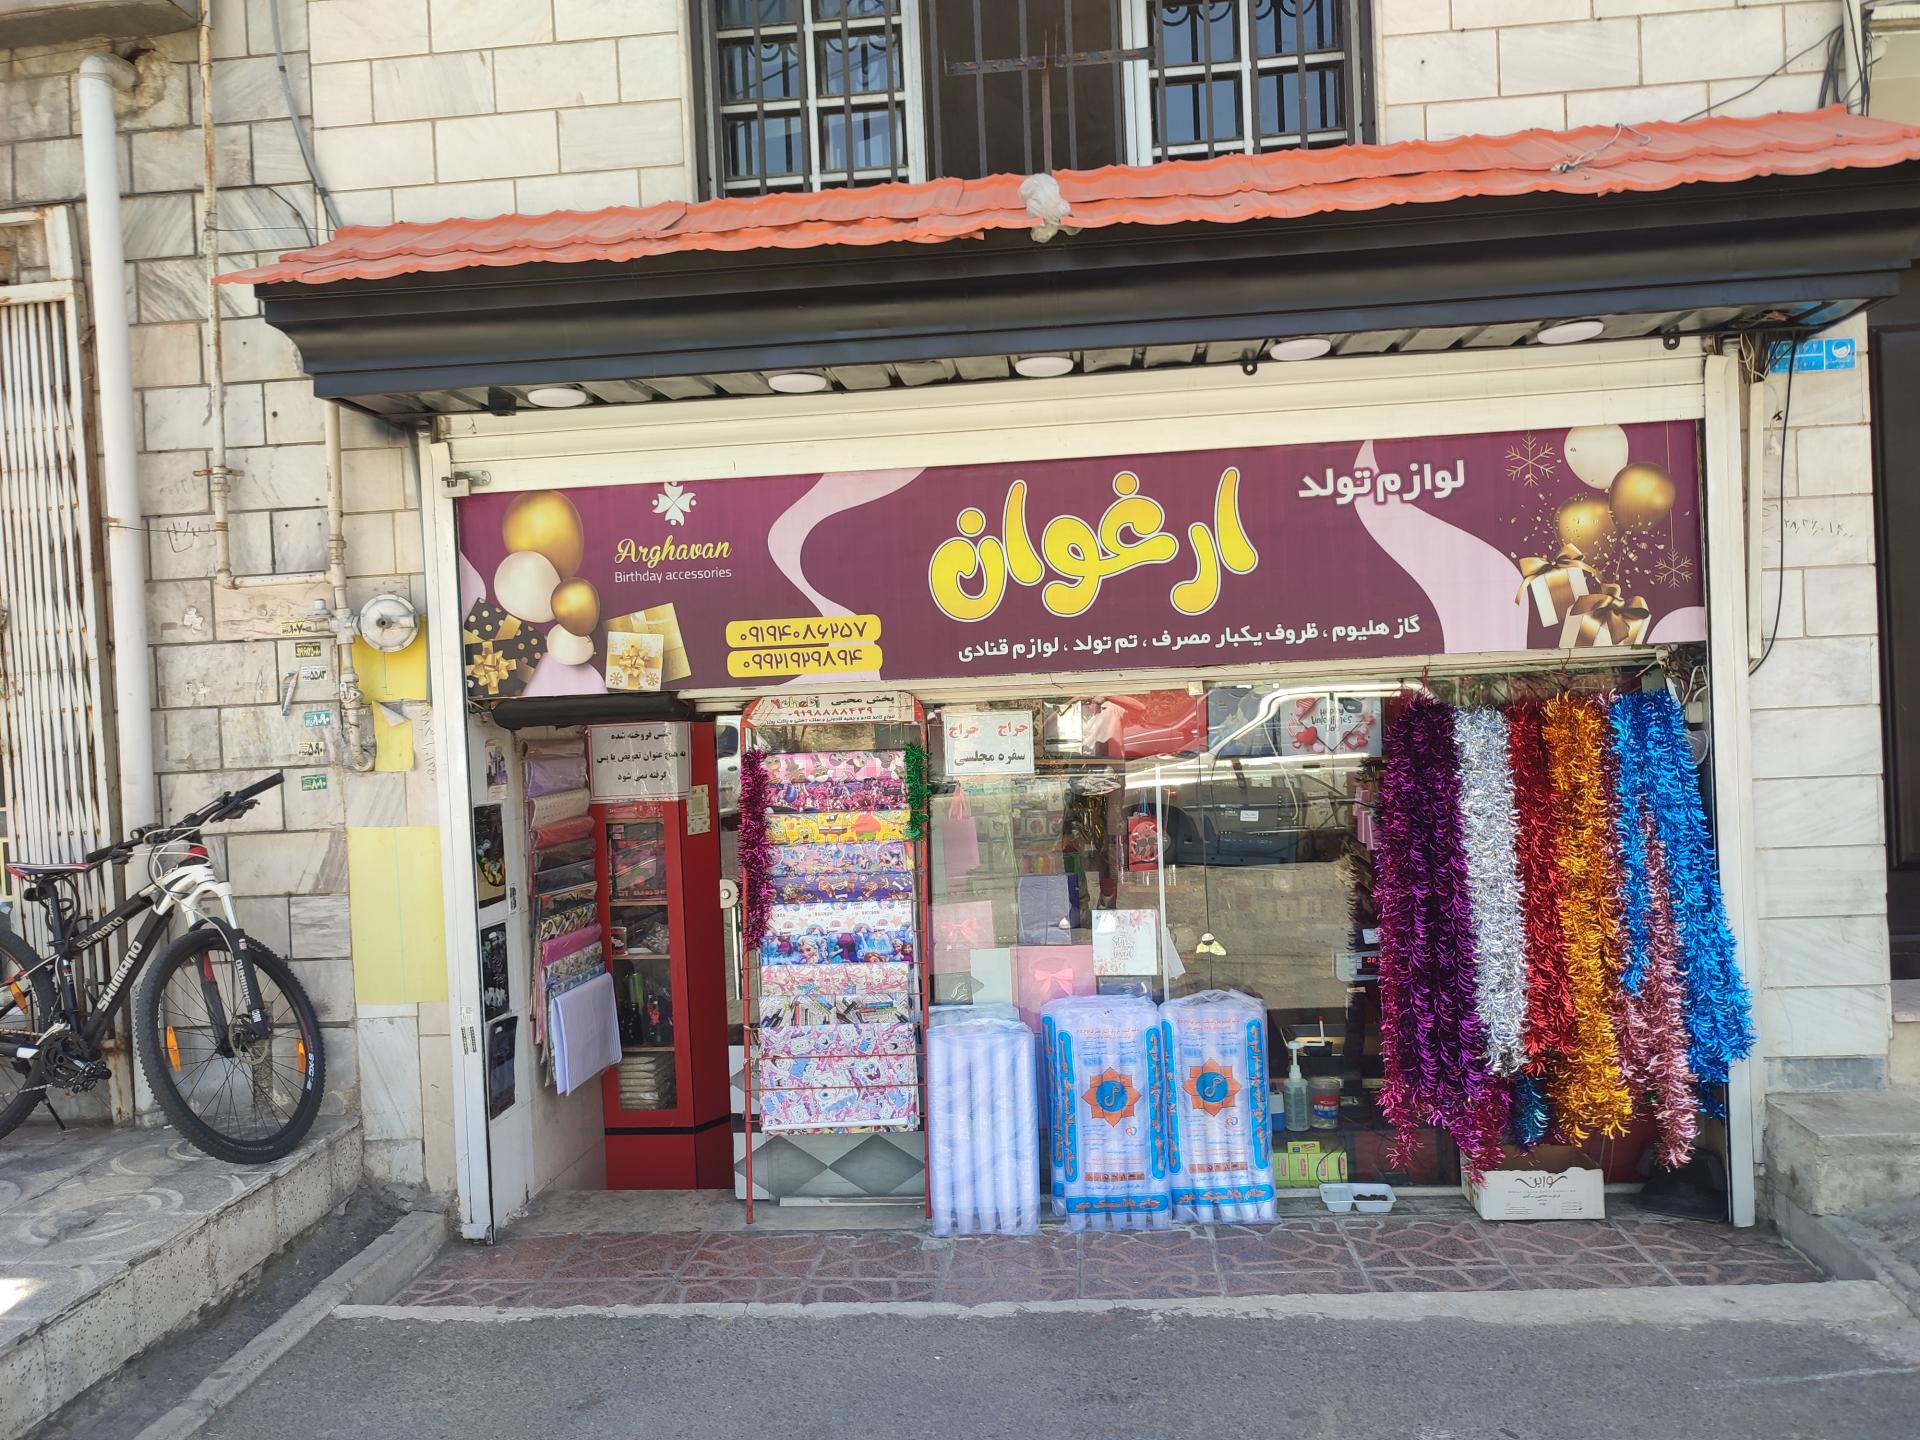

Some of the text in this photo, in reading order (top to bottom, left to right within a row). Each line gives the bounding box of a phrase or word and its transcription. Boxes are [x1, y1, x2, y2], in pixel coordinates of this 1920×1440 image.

[1298, 460, 1465, 505] لوازم تولد
[614, 534, 732, 568] Arghavan
[928, 466, 1259, 623] ارغوان
[614, 567, 732, 583] Birthday accessories
[740, 621, 867, 642] ۰۹۱۹۴۰۸۶۲۵۷
[1215, 625, 1262, 648] یکبار
[1266, 622, 1318, 644] ظروف
[1332, 620, 1389, 641] هلیوم
[1394, 614, 1421, 639] گاز
[958, 638, 1009, 662] قنادی
[1012, 637, 1059, 659] لوازم
[1073, 635, 1112, 655] تولد
[1115, 634, 1138, 653] تم
[1152, 630, 1210, 651] مصرف
[743, 649, 863, 670] ۰۹۹۲۱۹۲۹۸۹۴
[867, 696, 895, 705] پخش
[948, 721, 1029, 738] حراج حراج
[954, 749, 995, 766] مجلسی
[97, 941, 143, 1012] SHIMANO
